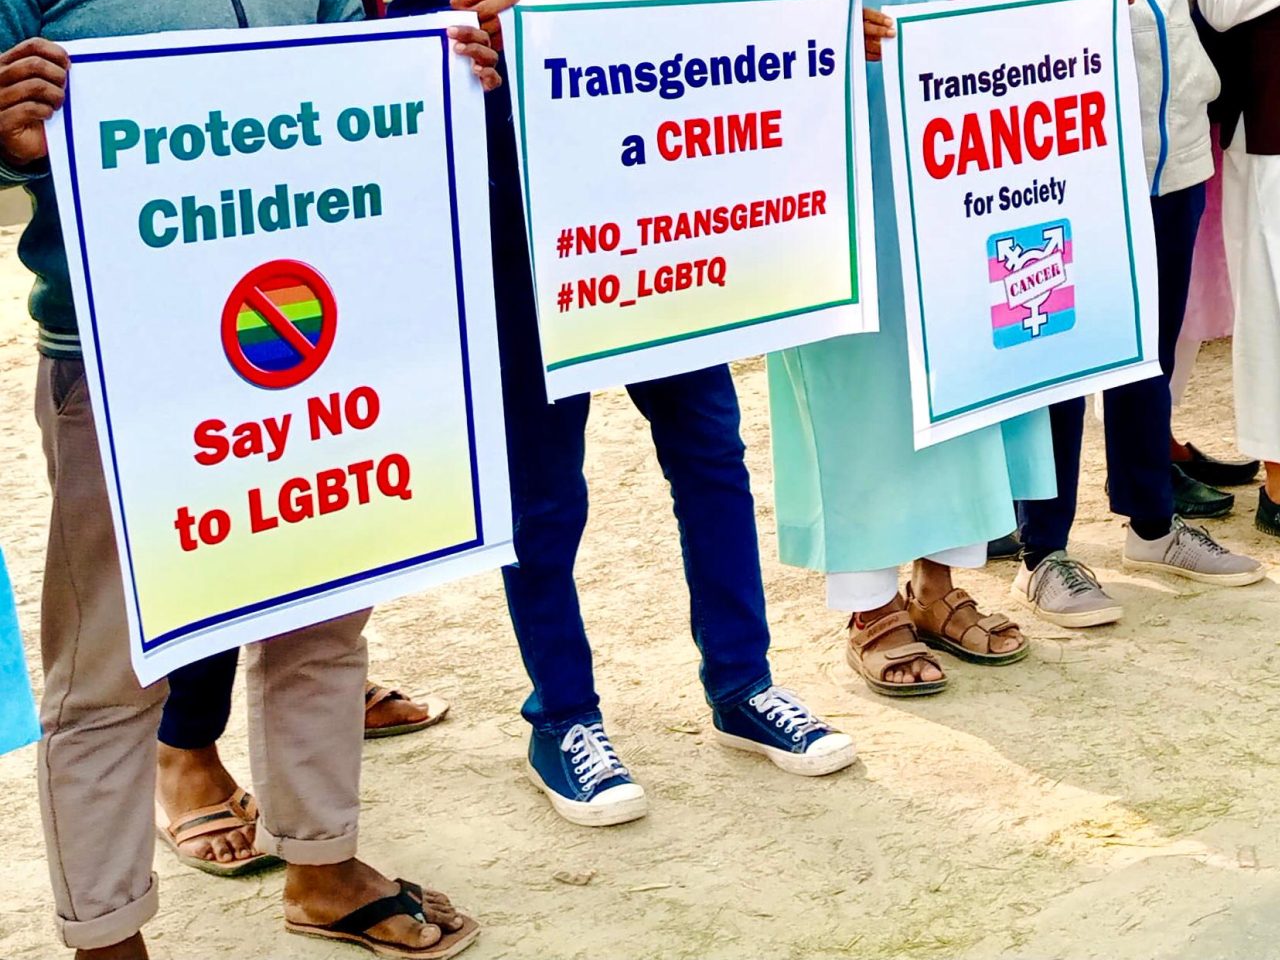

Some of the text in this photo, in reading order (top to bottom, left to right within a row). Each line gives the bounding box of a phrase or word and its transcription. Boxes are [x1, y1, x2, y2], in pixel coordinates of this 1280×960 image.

[544, 40, 836, 100] Transgender is
[919, 48, 1102, 104] Transgender is
[100, 99, 424, 170] Protect our
[620, 110, 783, 167] a CRIME
[920, 90, 1108, 181] CANCER
[139, 182, 383, 249] Children
[556, 189, 828, 259] #NO_TRANSGENDER
[963, 176, 1067, 220] for Society
[556, 255, 728, 313] #NO_LGBTQ
[1010, 263, 1060, 297] CANCER
[192, 385, 380, 467] Say NO
[174, 452, 413, 553] to LGBTQ
